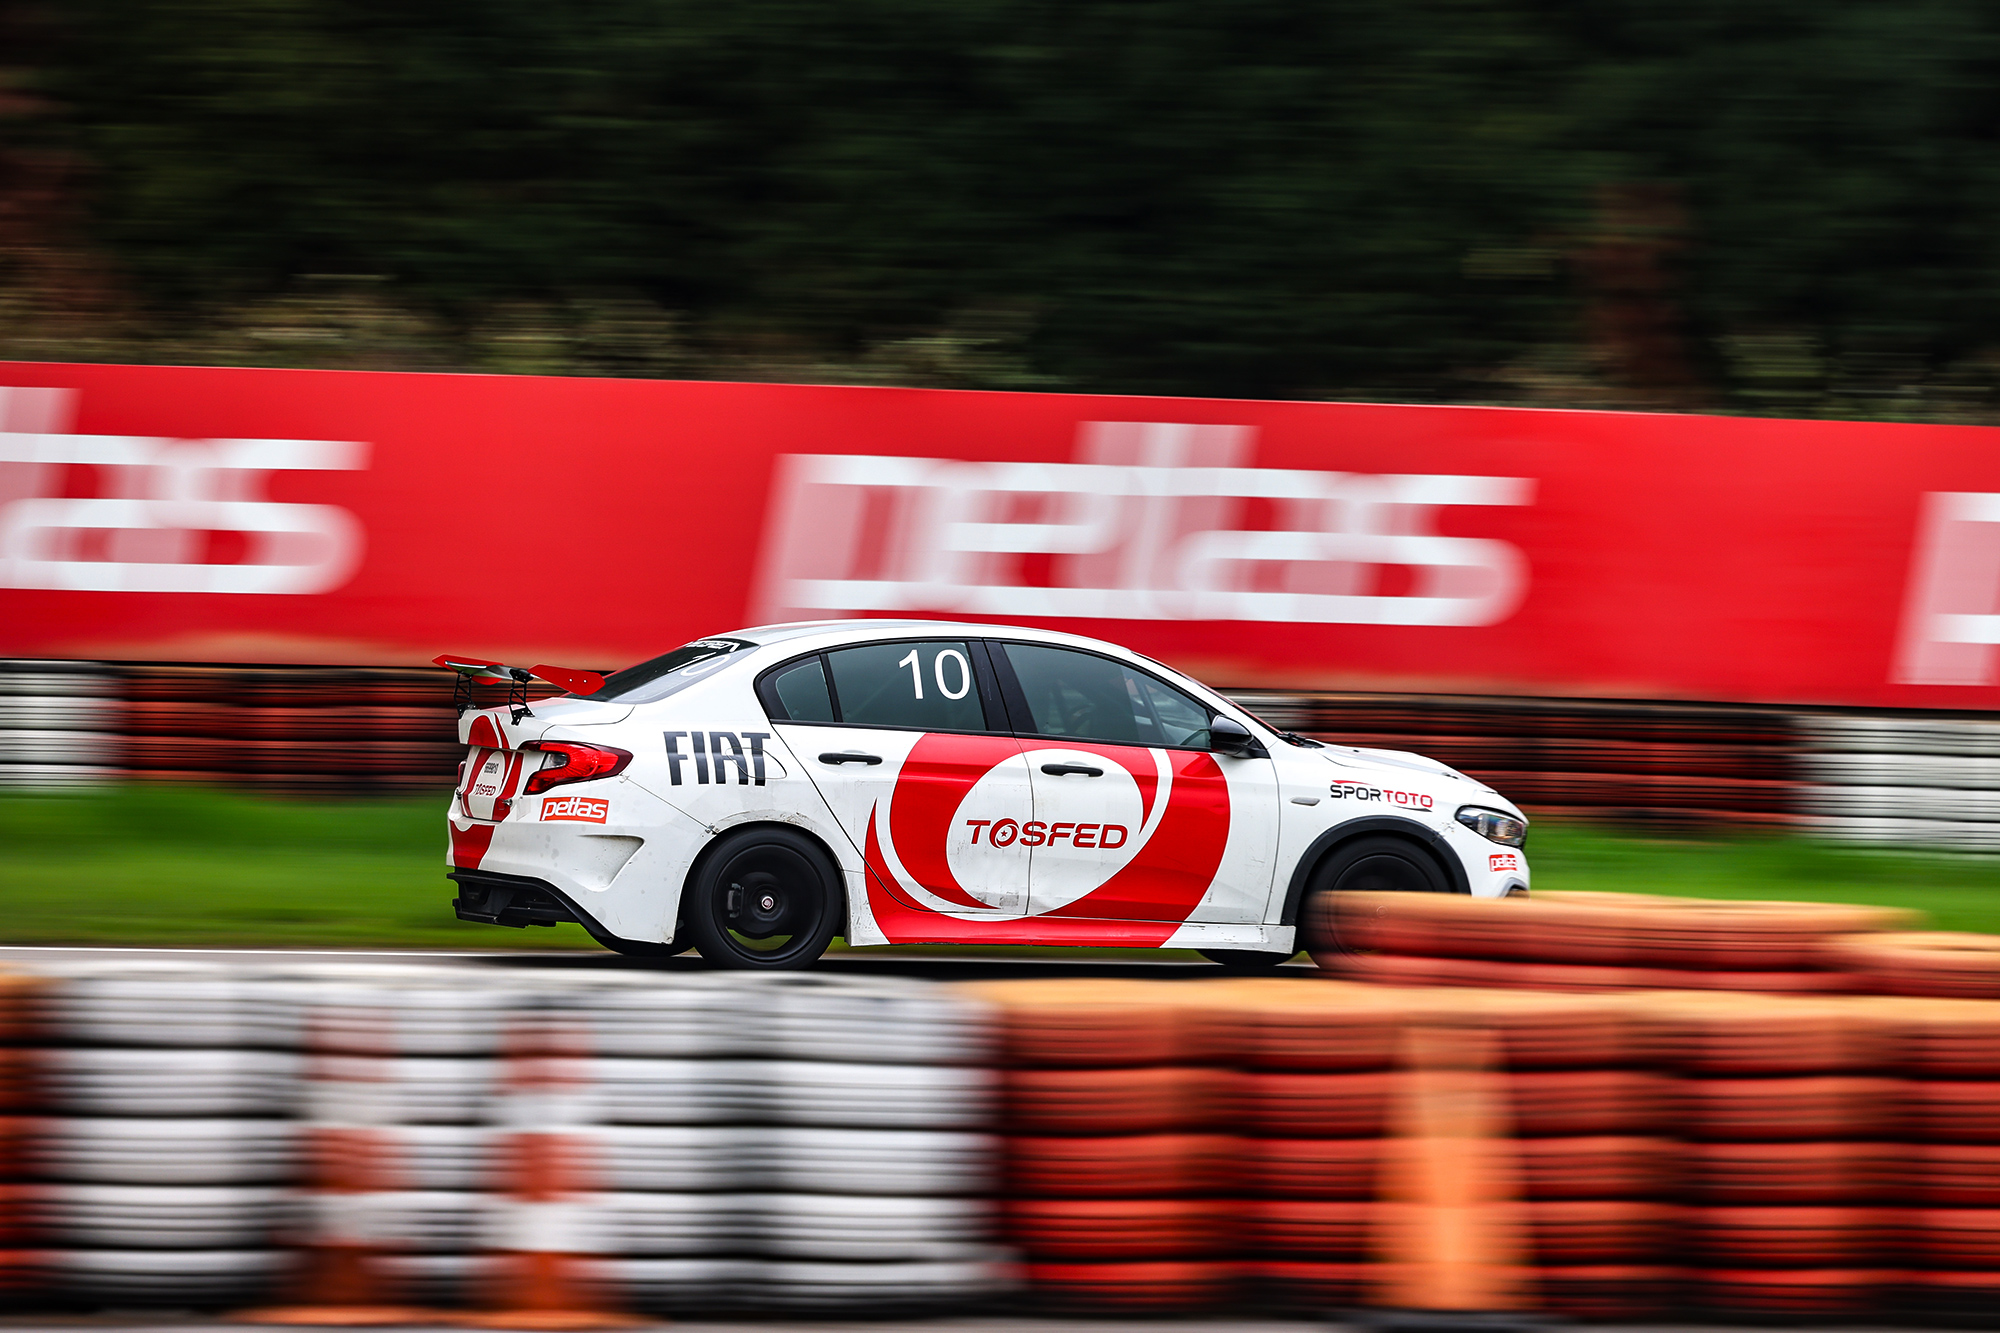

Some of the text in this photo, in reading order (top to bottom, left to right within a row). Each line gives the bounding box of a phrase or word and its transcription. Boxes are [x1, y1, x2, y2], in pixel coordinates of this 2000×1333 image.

[899, 649, 970, 700] 10
[663, 731, 771, 786] FIAT
[541, 797, 607, 820] petlas
[966, 818, 1128, 849] TOSFED
